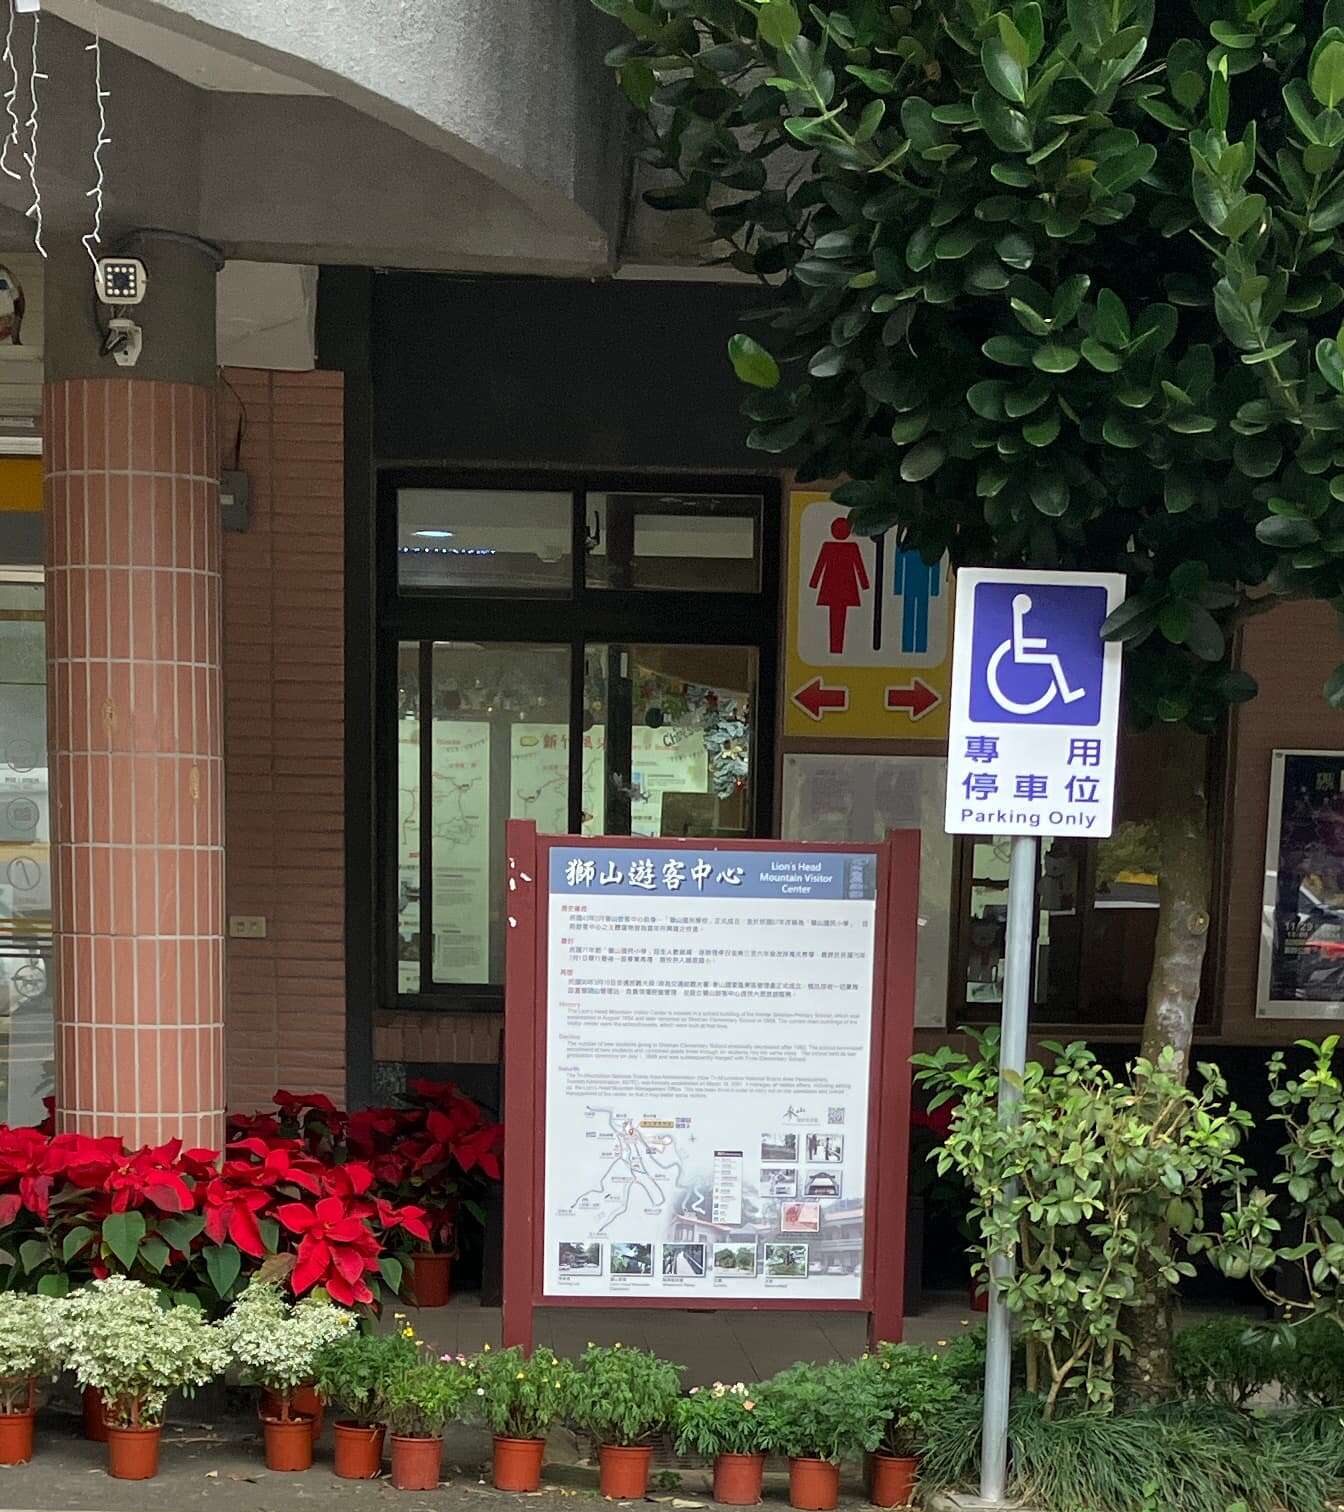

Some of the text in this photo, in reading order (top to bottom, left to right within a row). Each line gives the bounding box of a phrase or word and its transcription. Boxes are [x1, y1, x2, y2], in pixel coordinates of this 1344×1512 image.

[962, 772, 1101, 804] 停車位
[960, 808, 1097, 829] Parking Only
[565, 858, 745, 891] 獅山遊客中心
[771, 861, 823, 872] Lion's Head
[759, 872, 834, 884] Mountain Visitor
[781, 884, 812, 894] Center
